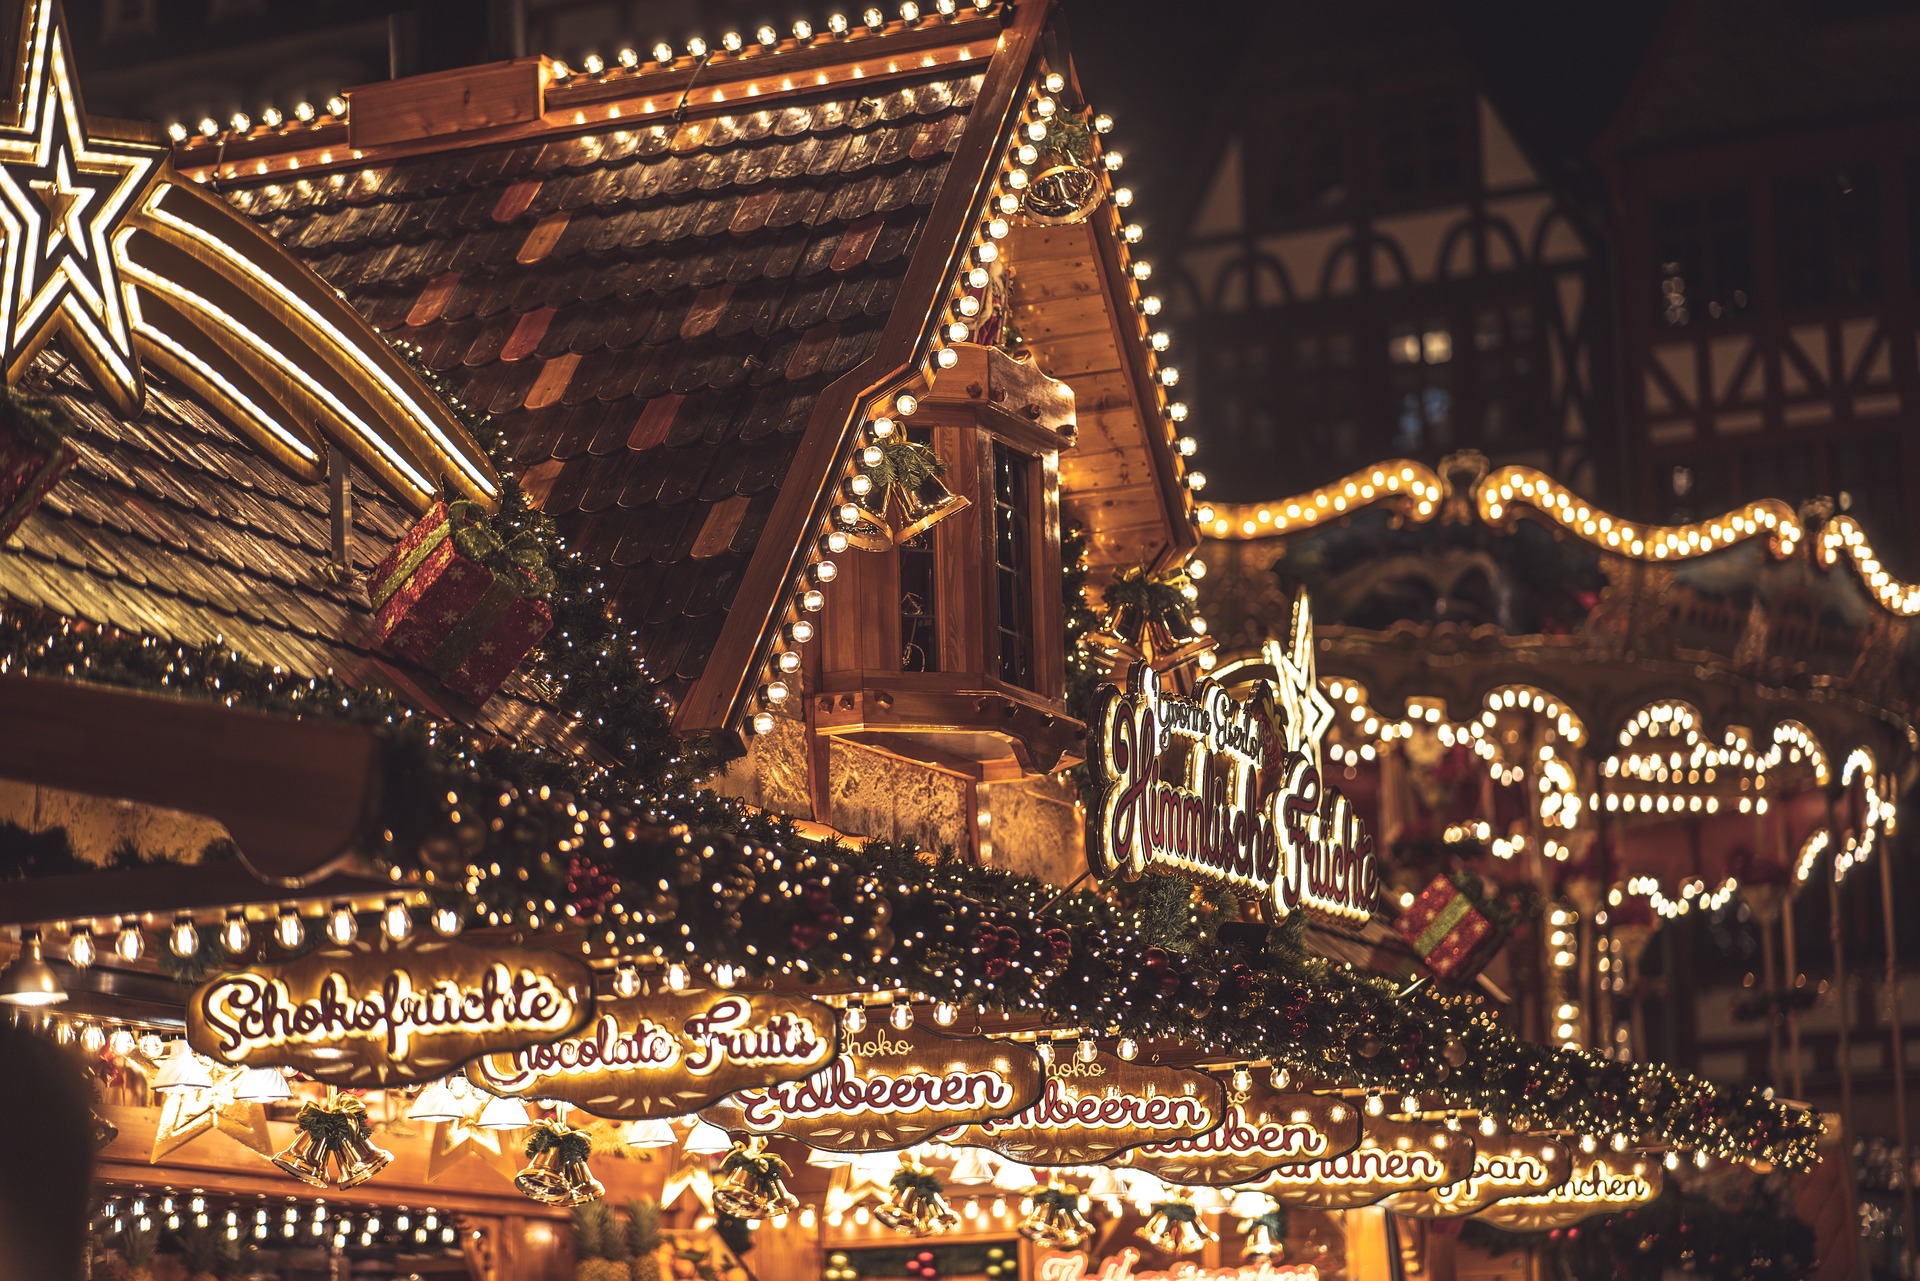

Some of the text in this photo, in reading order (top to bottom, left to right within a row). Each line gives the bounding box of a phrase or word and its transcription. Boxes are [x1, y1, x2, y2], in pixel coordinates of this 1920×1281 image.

[1111, 698, 1381, 914] Himmlische Früchte
[202, 965, 561, 1055] Schokofrüchte
[686, 998, 818, 1070] Fruits
[735, 1059, 1006, 1125] Erdbeeren
